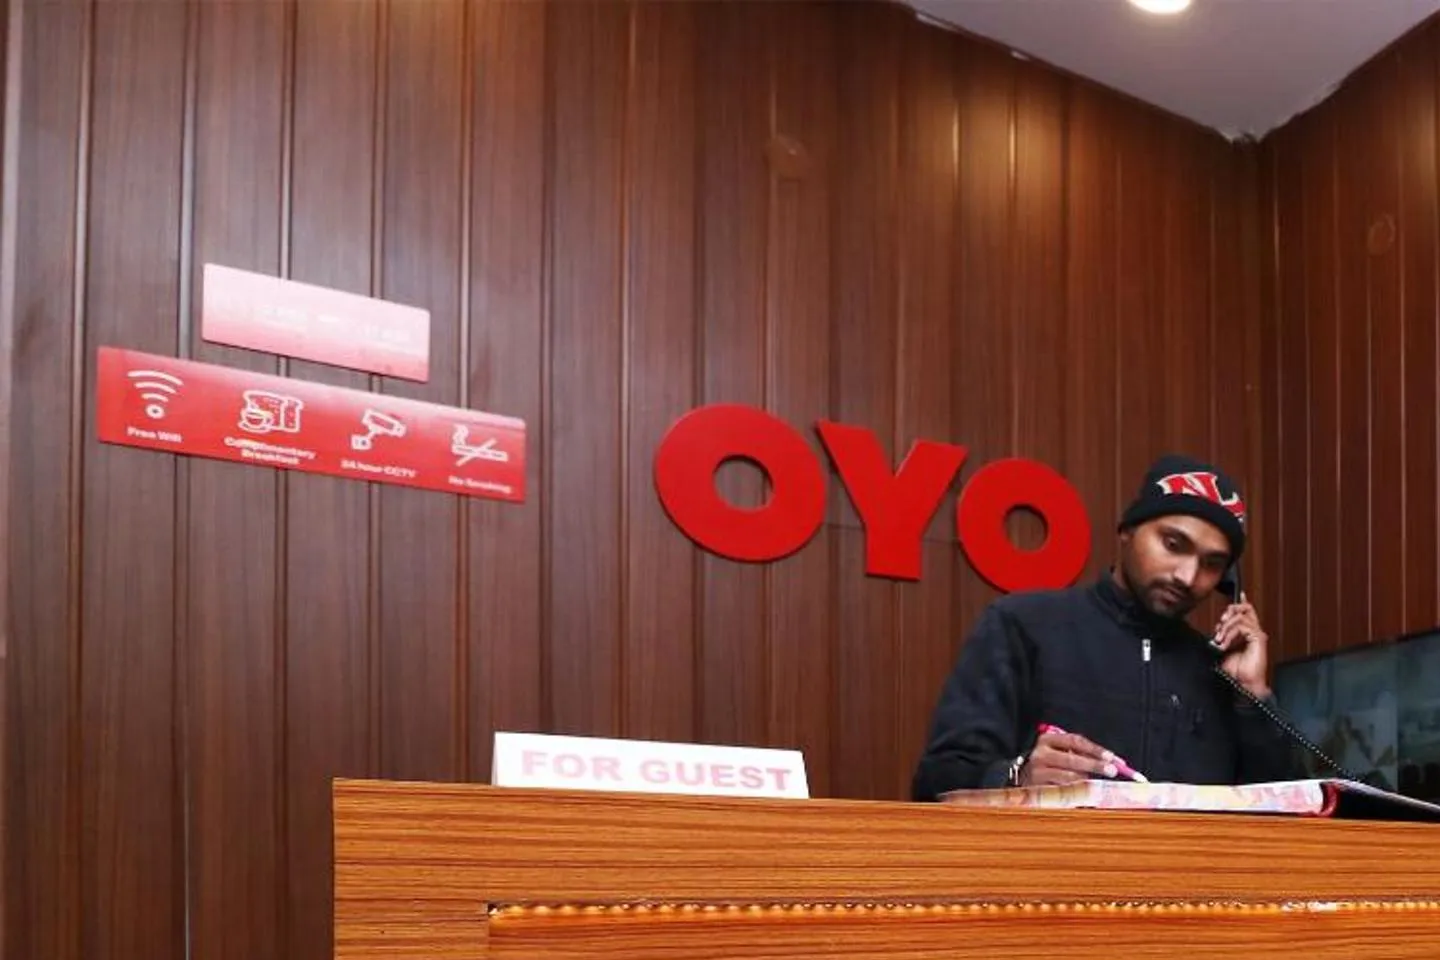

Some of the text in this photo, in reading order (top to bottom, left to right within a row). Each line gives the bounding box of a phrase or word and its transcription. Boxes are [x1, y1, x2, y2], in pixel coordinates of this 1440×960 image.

[127, 426, 156, 438] Free
[384, 466, 416, 478] CCTV
[654, 403, 1091, 593] OYO
[522, 750, 792, 790] FOR GUEST
